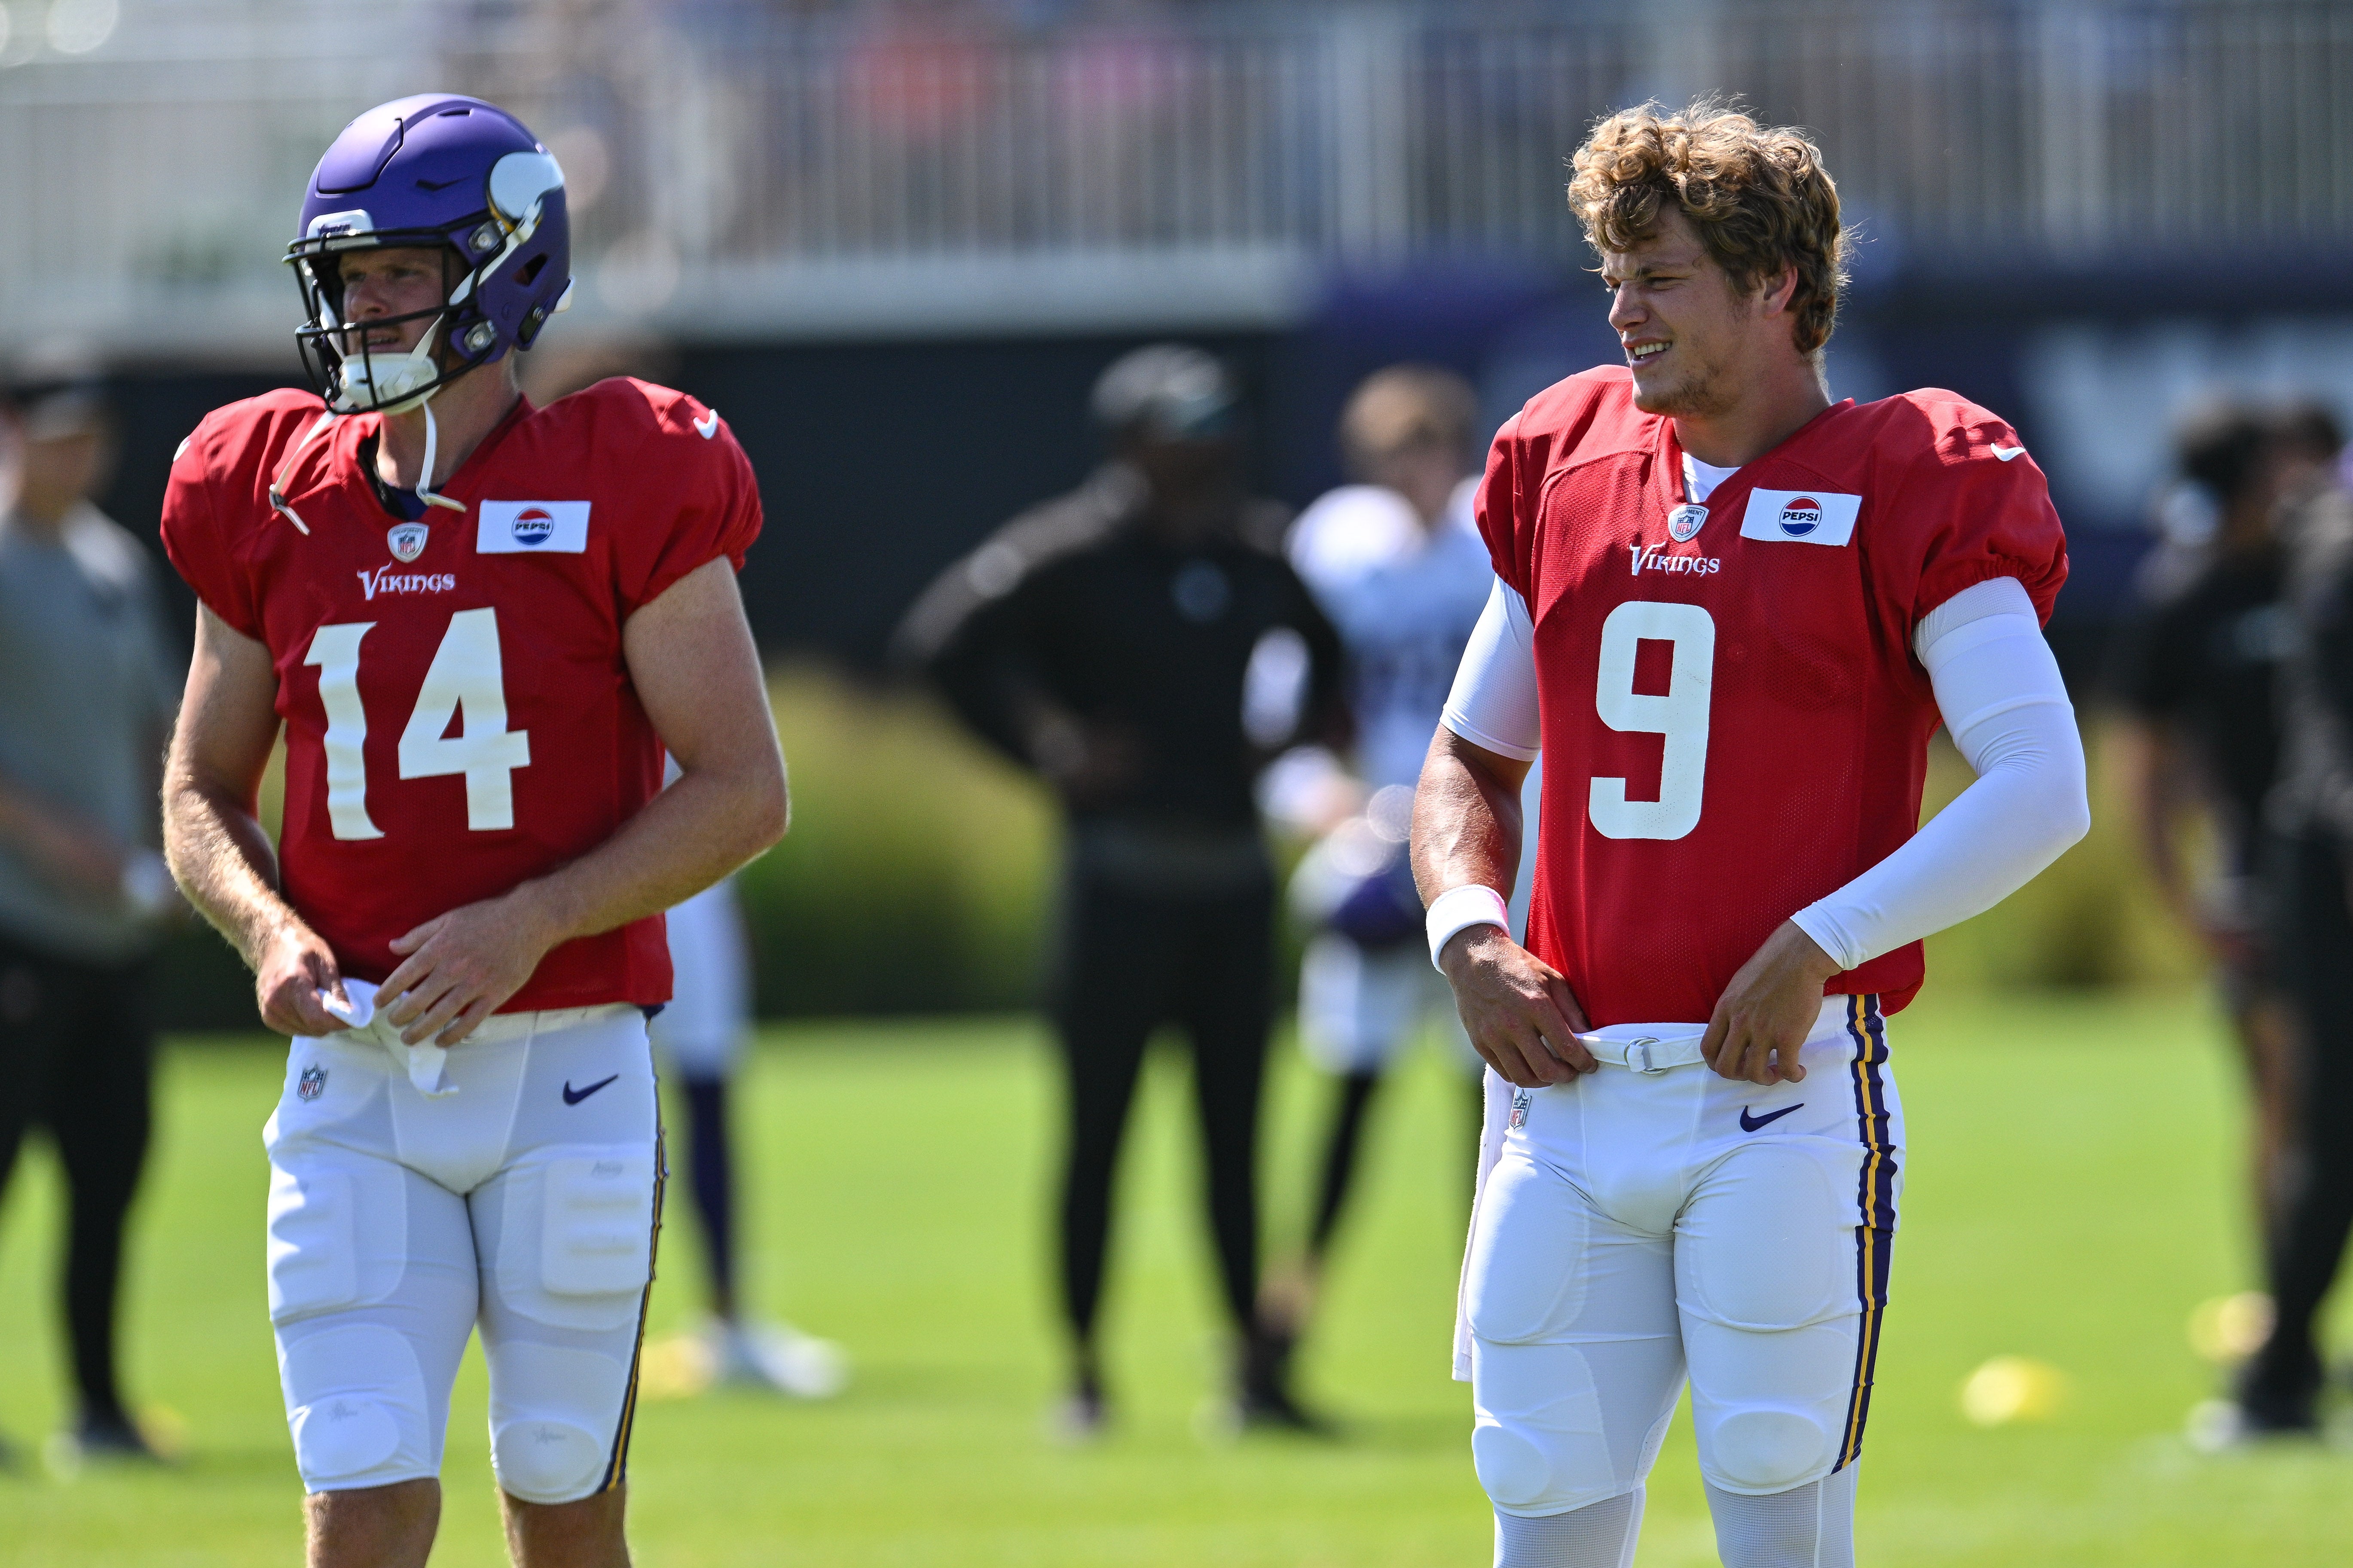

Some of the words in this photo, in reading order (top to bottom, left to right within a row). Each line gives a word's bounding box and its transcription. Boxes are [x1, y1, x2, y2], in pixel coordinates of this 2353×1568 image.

[1782, 511, 1818, 522] PEPSI
[1677, 524, 1690, 533] NFL
[303, 607, 531, 841] 14
[1589, 601, 1715, 841] 9
[301, 1083, 319, 1097] NFL
